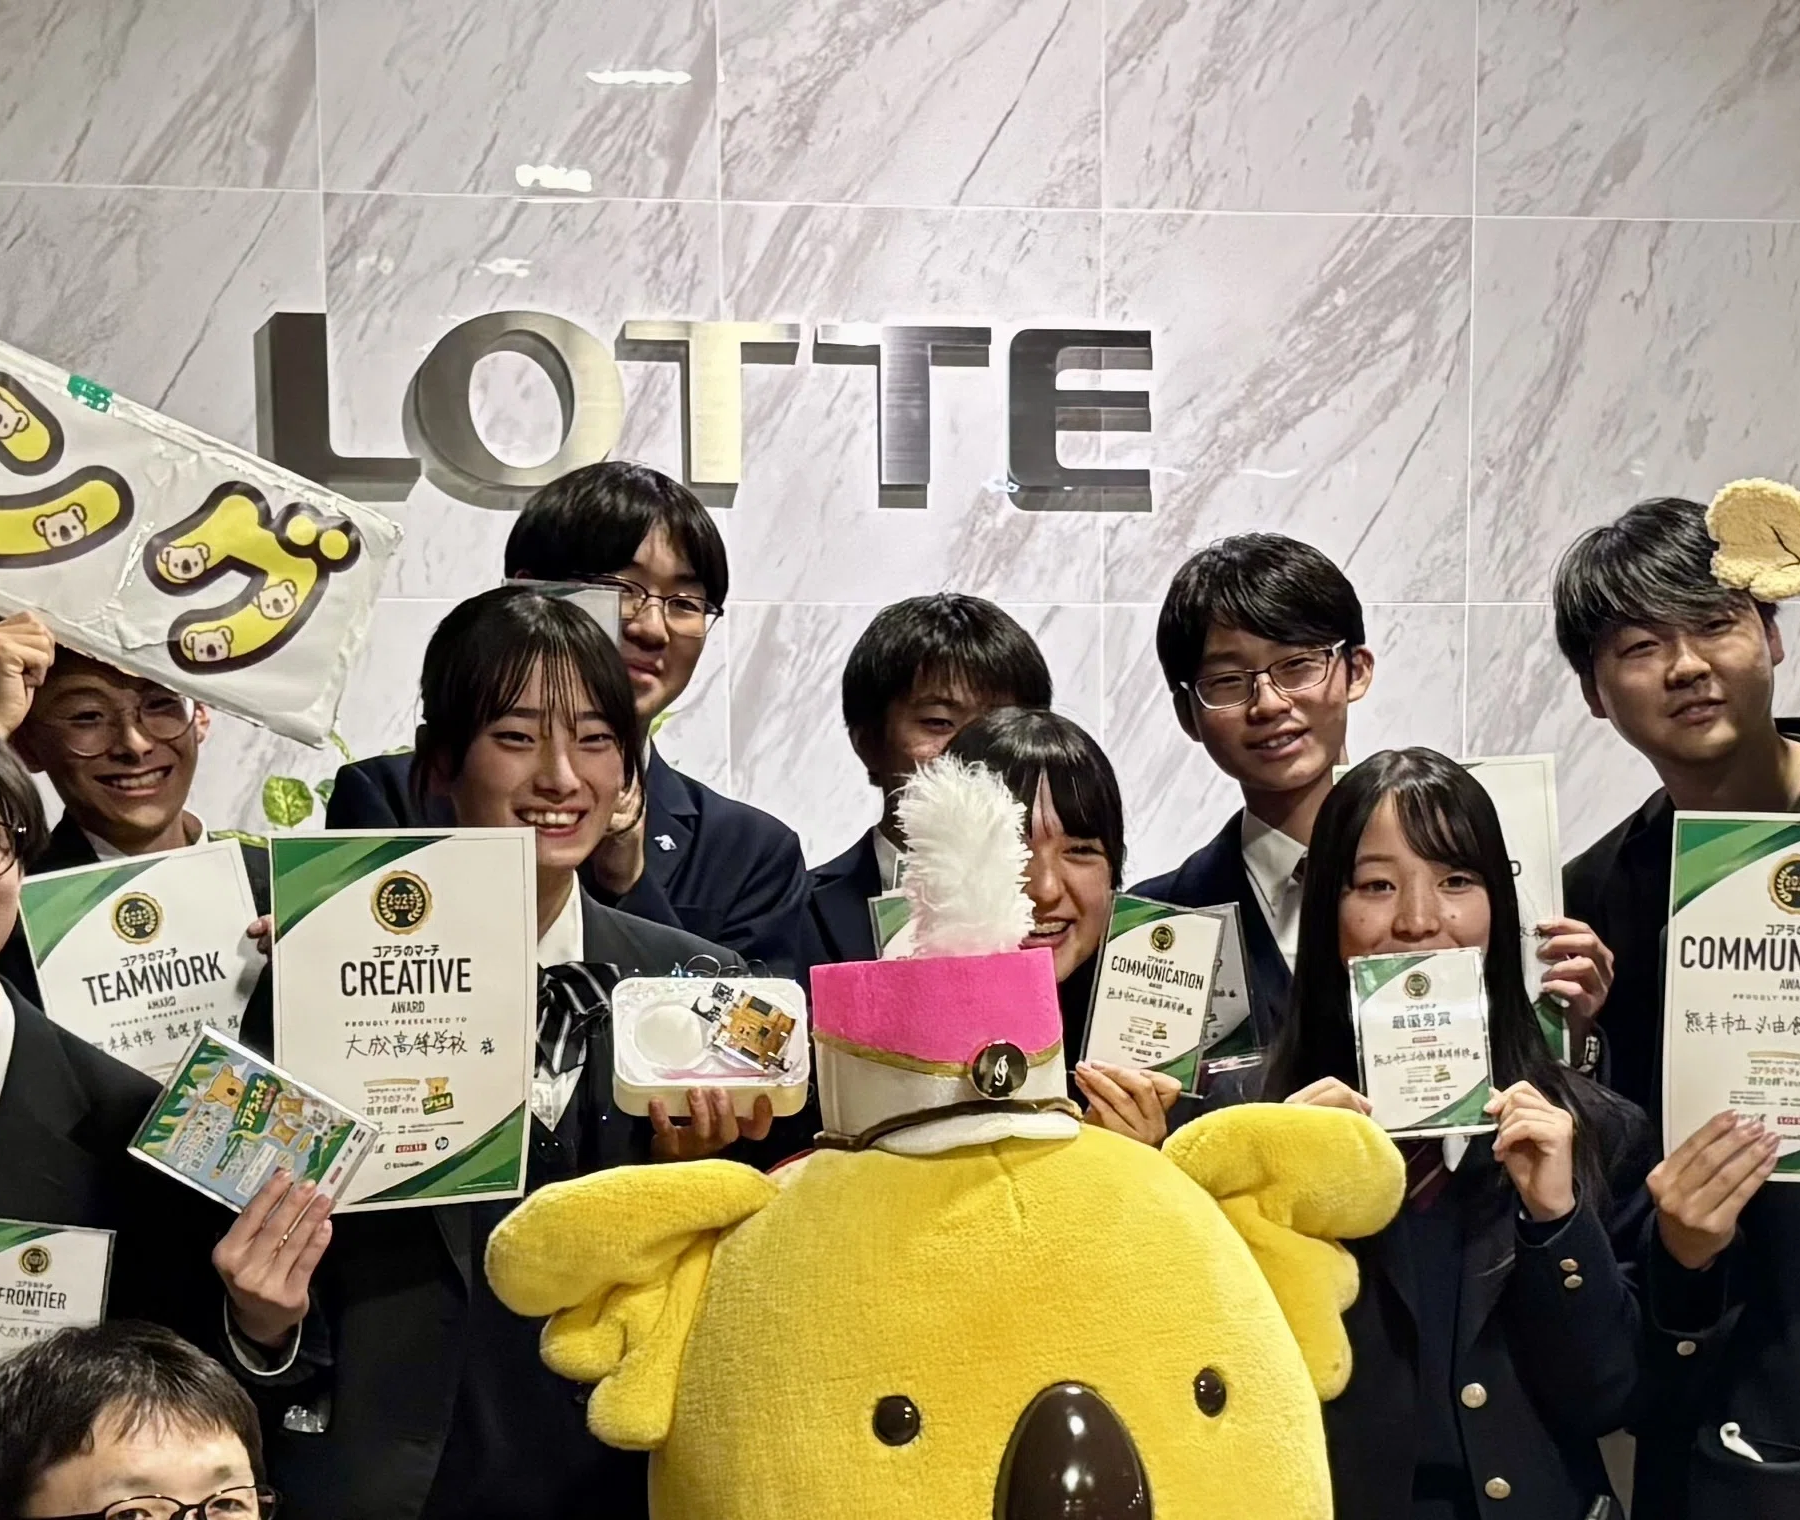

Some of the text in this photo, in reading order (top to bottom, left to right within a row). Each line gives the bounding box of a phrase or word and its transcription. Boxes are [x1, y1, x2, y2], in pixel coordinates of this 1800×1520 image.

[255, 311, 1153, 512] LOTTE
[372, 945, 439, 958] コアラのマーチ
[82, 951, 227, 1006] TEAMWORK
[341, 958, 472, 997] CREATIVE
[1111, 955, 1205, 990] COMMUNICATION
[391, 1001, 425, 1014] AWARD
